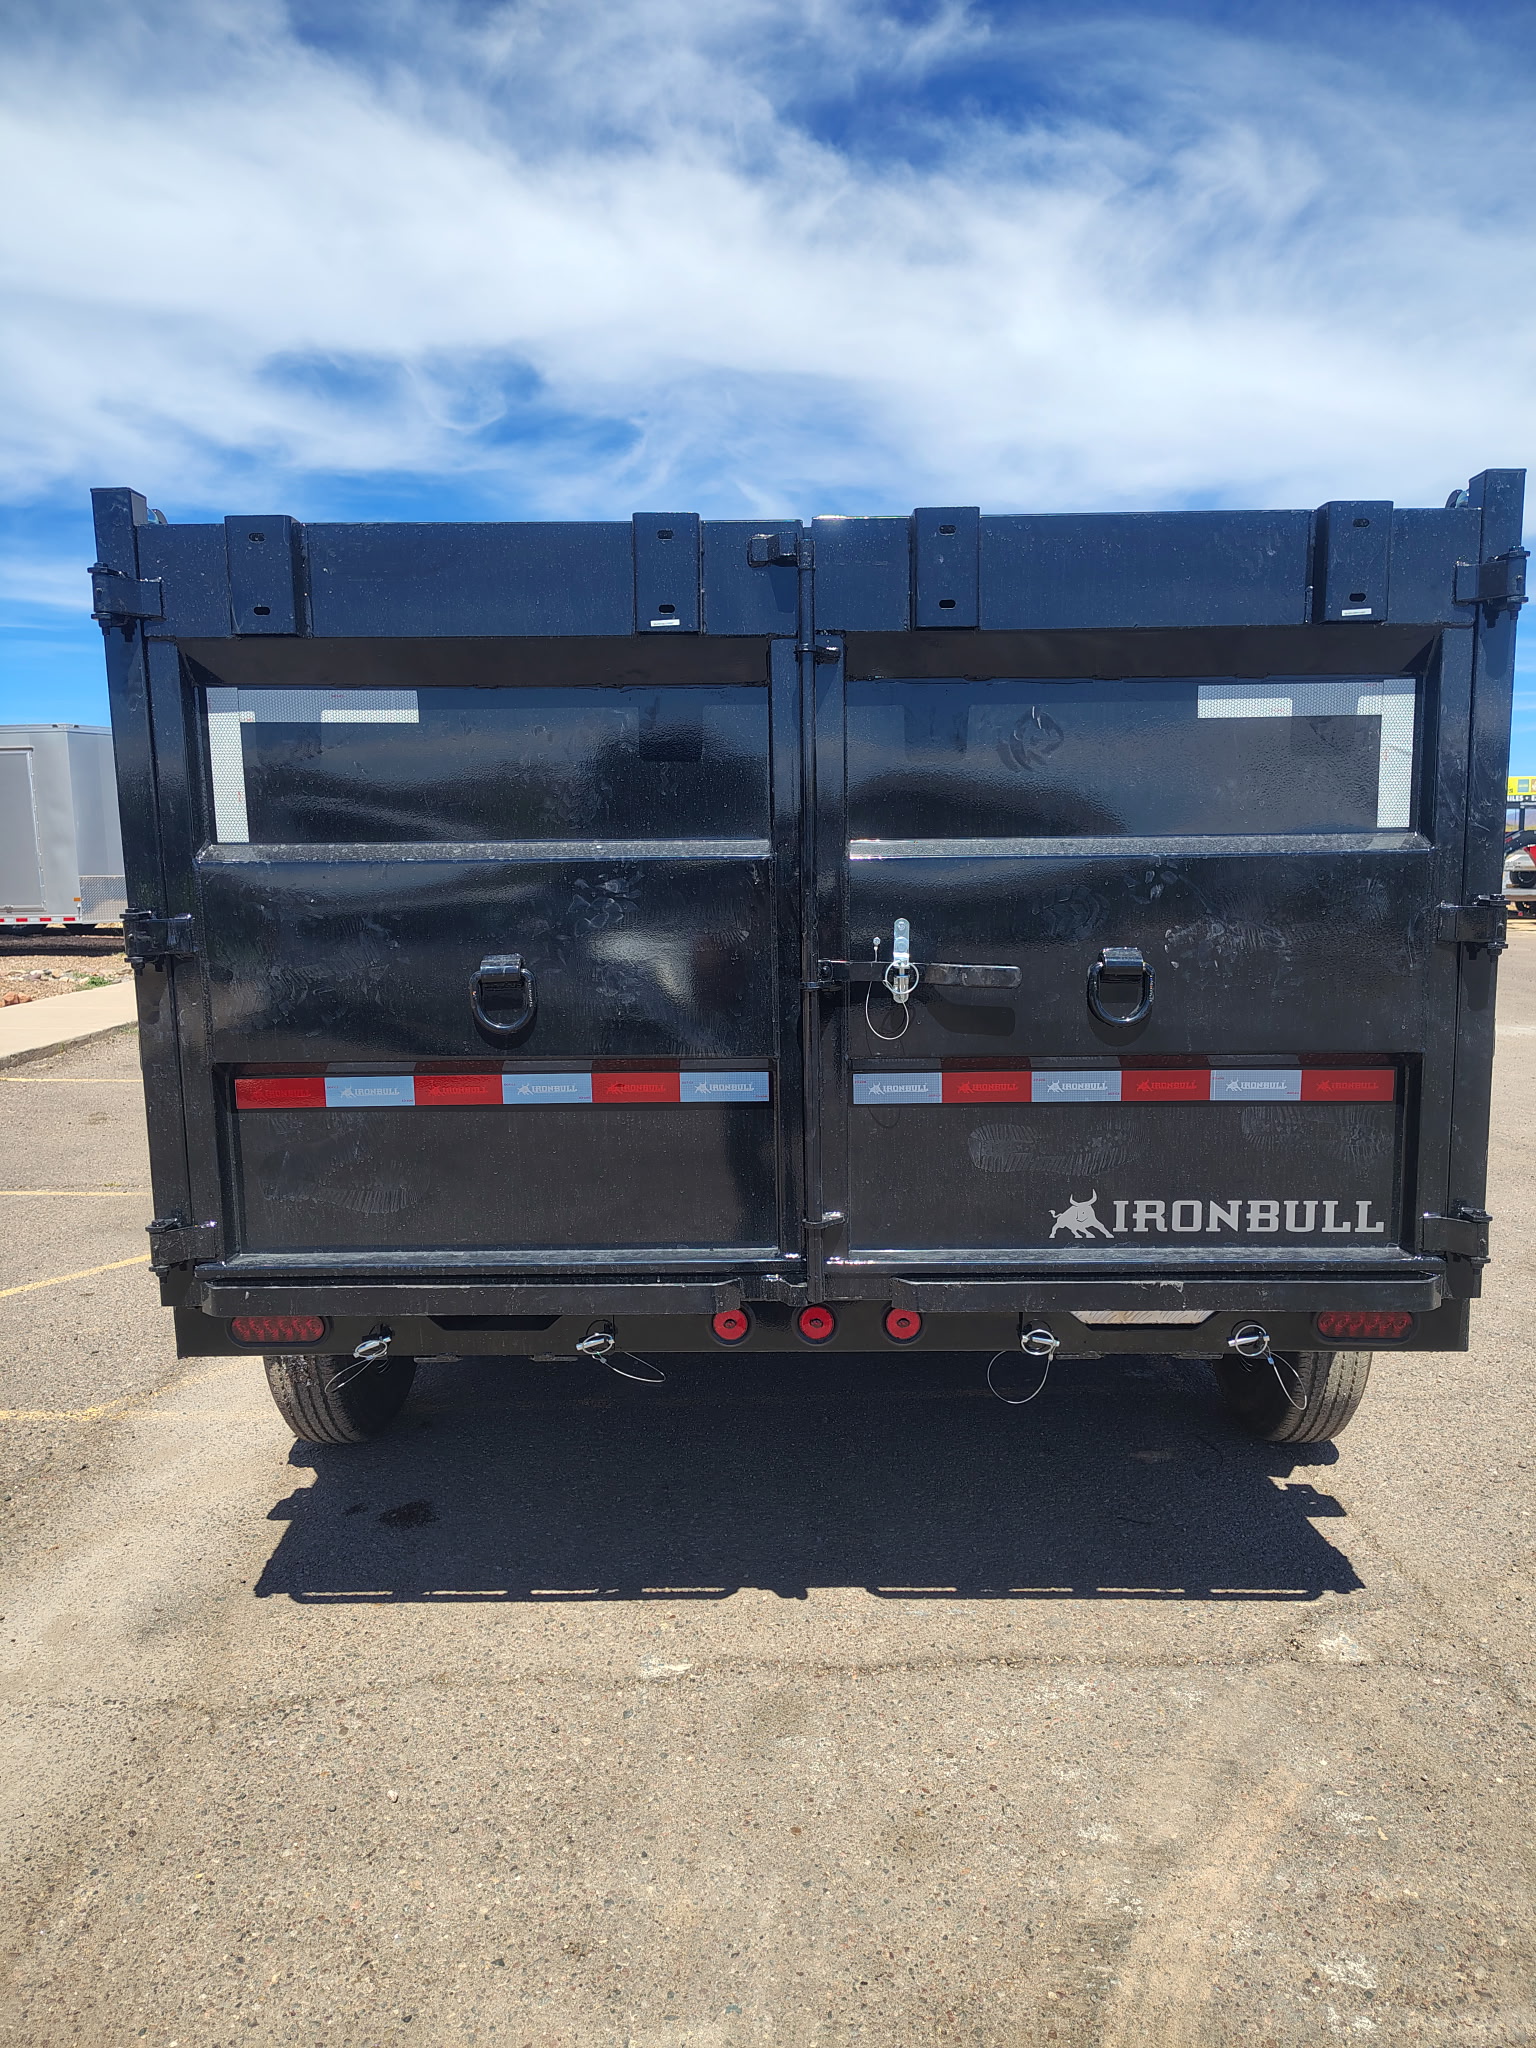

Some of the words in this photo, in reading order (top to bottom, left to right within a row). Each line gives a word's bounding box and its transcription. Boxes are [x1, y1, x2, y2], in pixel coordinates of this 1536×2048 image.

[532, 1084, 578, 1093] IRONBULL
[710, 1083, 755, 1092] IRONBULL
[883, 1083, 929, 1093] IRONBULL
[972, 1082, 1019, 1091] IRONBULL
[1062, 1082, 1108, 1091] IRONBULL
[1151, 1081, 1197, 1090] IRONBULL
[1241, 1081, 1288, 1090] IRONBULL
[354, 1087, 400, 1096] IRONBULL
[1112, 1200, 1385, 1233] IRONBULL
